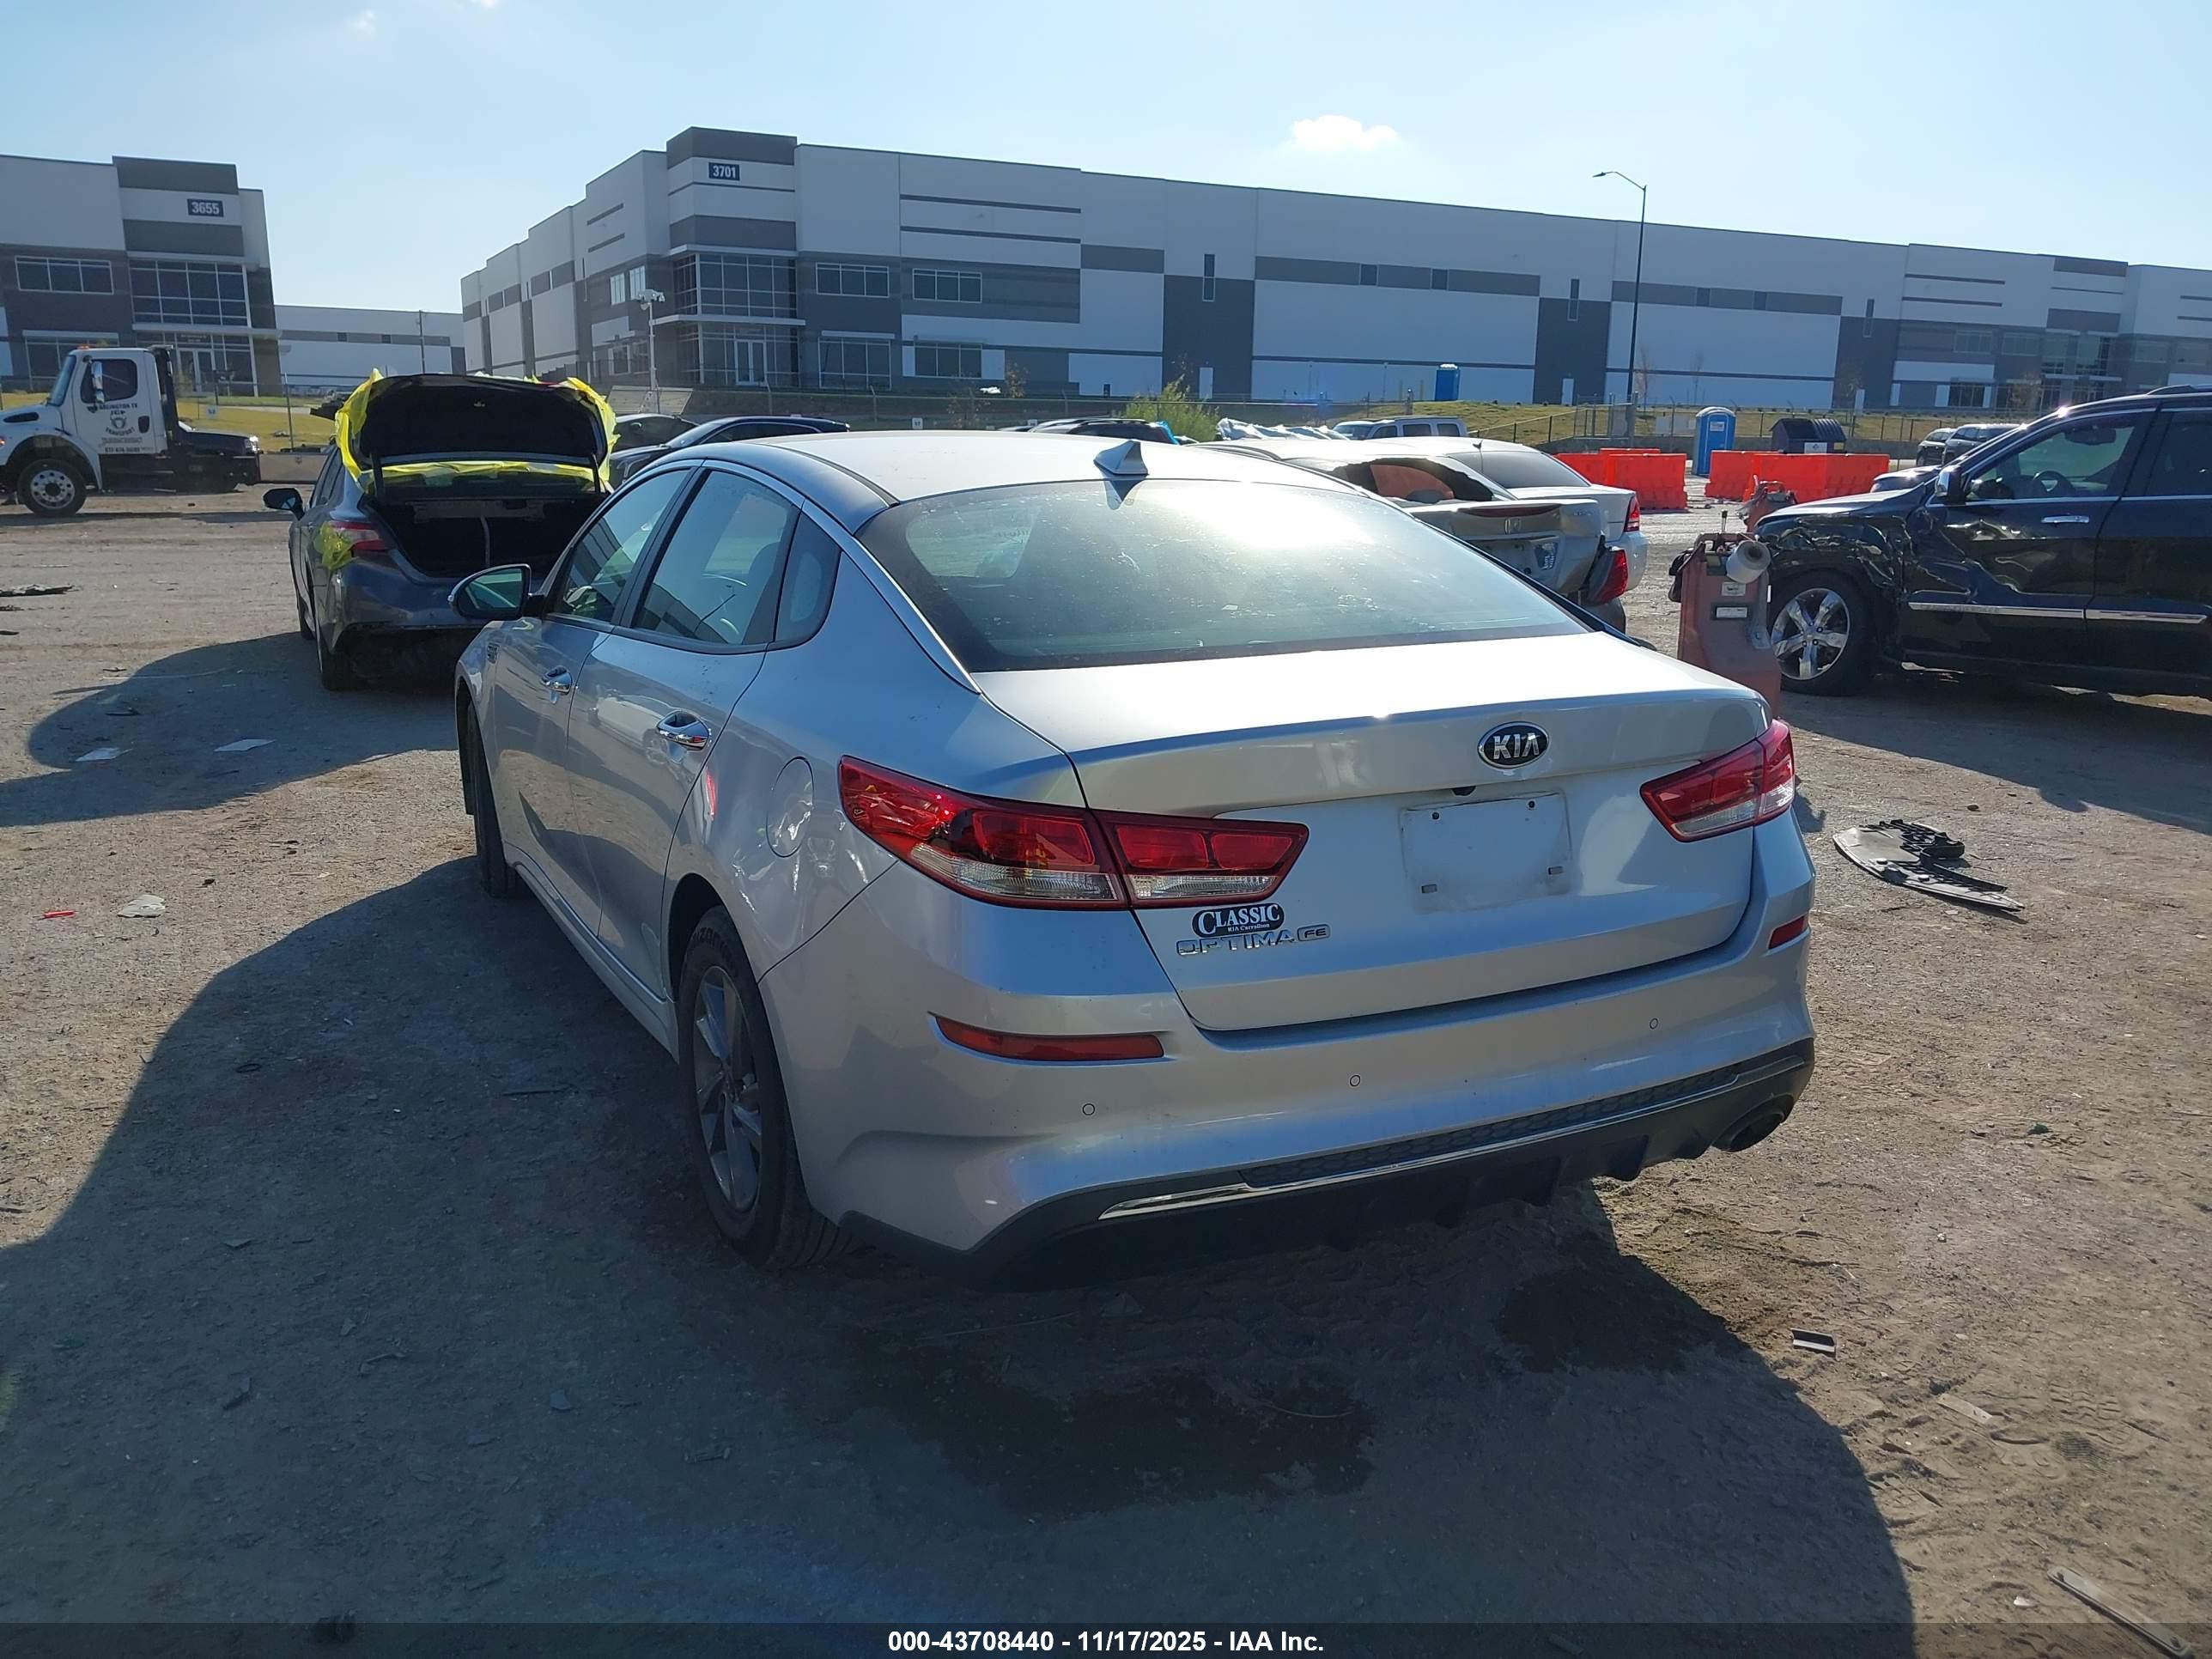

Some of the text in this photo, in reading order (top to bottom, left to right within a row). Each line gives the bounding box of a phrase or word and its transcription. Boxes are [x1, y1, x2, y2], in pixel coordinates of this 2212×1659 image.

[713, 165, 736, 179] 3701
[191, 201, 220, 215] 3655
[1492, 732, 1540, 760] KIA
[1198, 903, 1280, 935] CLASSIC
[1176, 927, 1327, 956] OPTIMA FE
